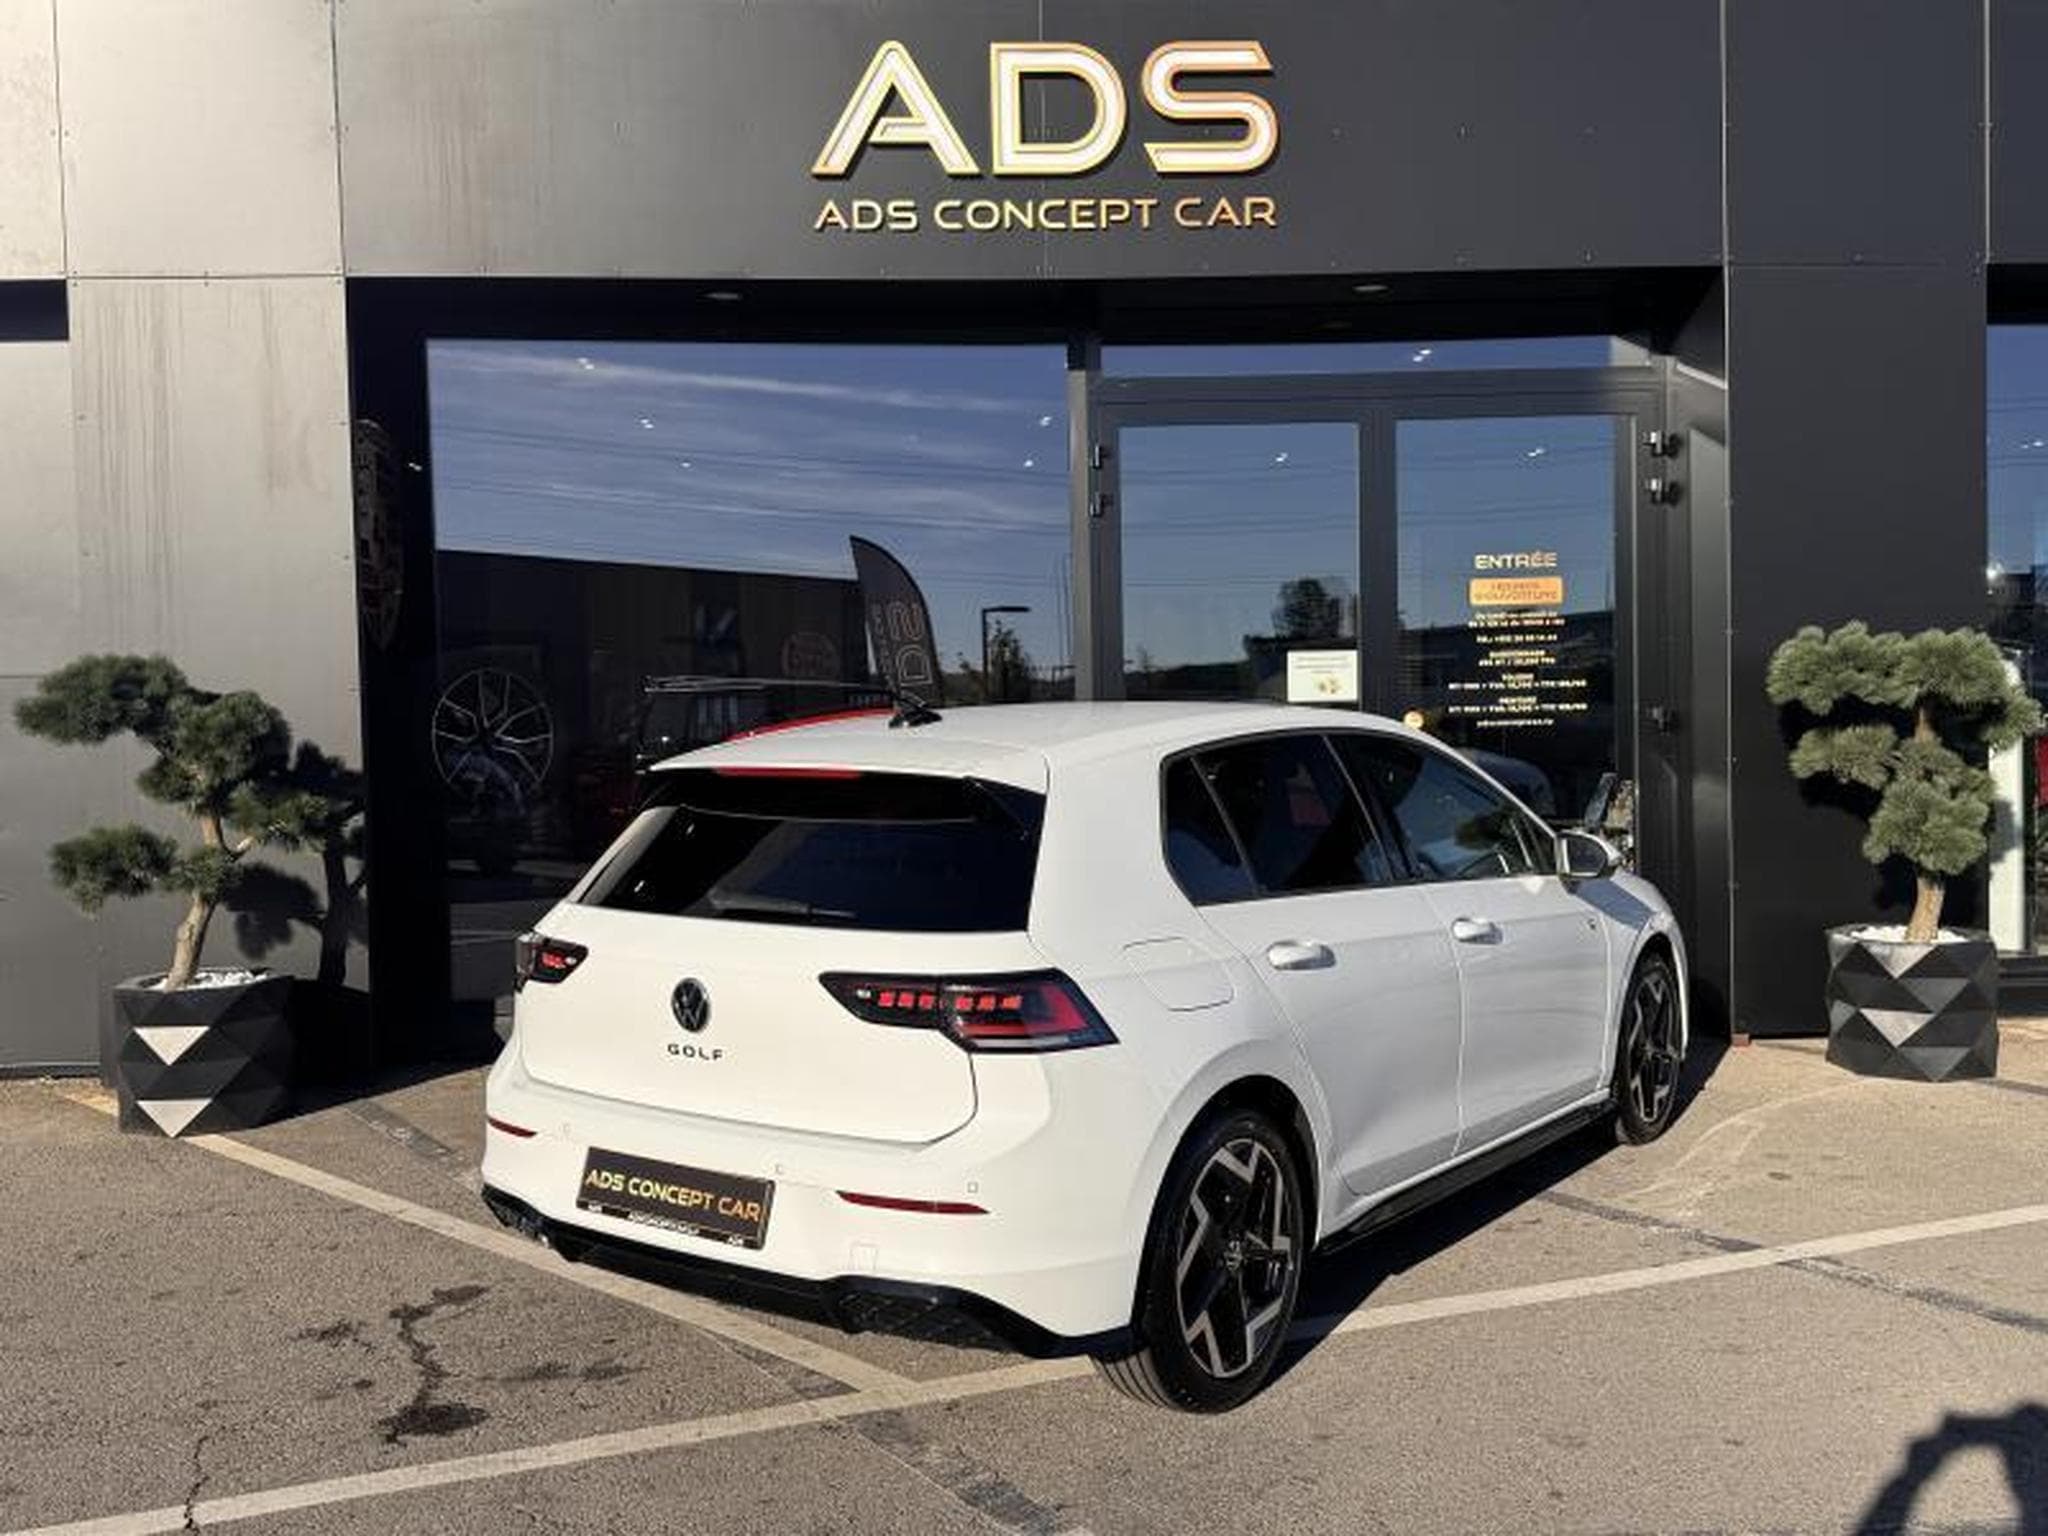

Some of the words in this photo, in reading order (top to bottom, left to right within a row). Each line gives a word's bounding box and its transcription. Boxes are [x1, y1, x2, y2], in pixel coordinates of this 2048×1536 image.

[811, 40, 1279, 175] ADS
[814, 199, 918, 231] ADS
[933, 197, 1160, 231] CONCEPT
[1174, 196, 1277, 227] CAR
[1474, 551, 1558, 570] ENTRÉE
[667, 1043, 723, 1061] GOLF
[585, 1168, 625, 1192] ADS
[627, 1177, 716, 1210] CONCEPT
[718, 1196, 762, 1222] CAR
